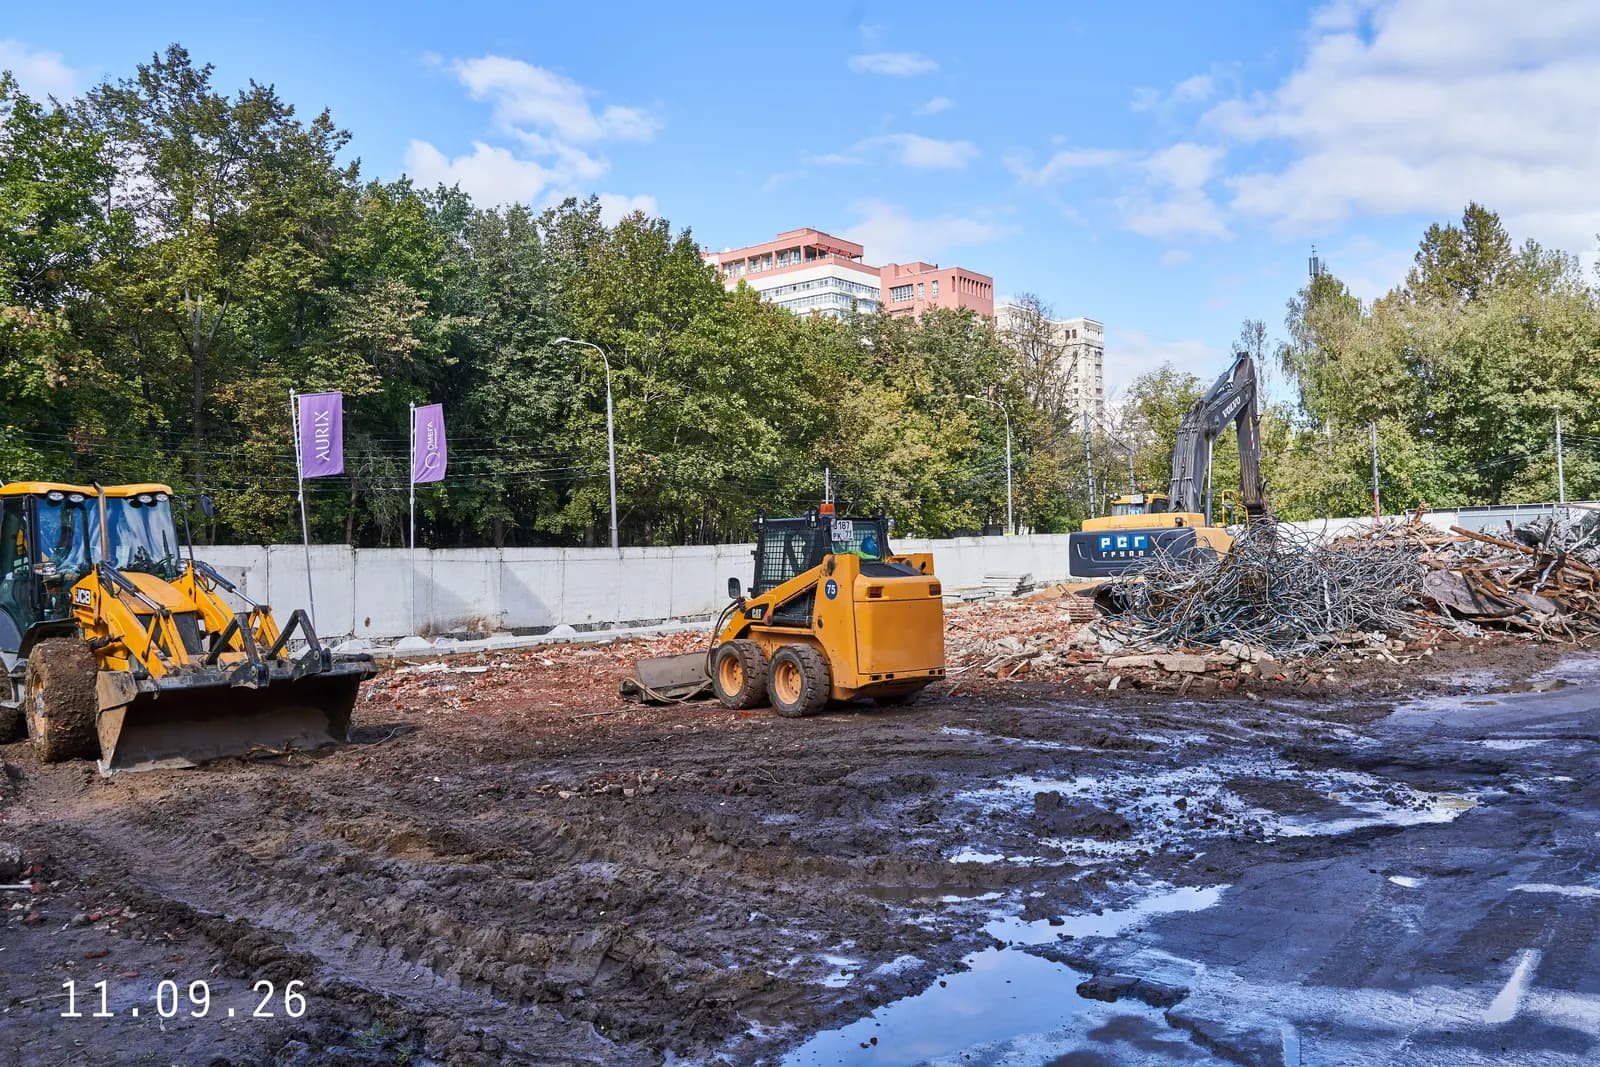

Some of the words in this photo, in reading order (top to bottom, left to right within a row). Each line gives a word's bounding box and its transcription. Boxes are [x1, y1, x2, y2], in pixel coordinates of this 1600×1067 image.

[1222, 396, 1241, 418] VOLVO
[314, 410, 330, 462] AURIX
[1101, 536, 1145, 549] РСГ
[76, 588, 91, 605] JCB
[827, 584, 836, 594] 75
[752, 608, 762, 619] CAT
